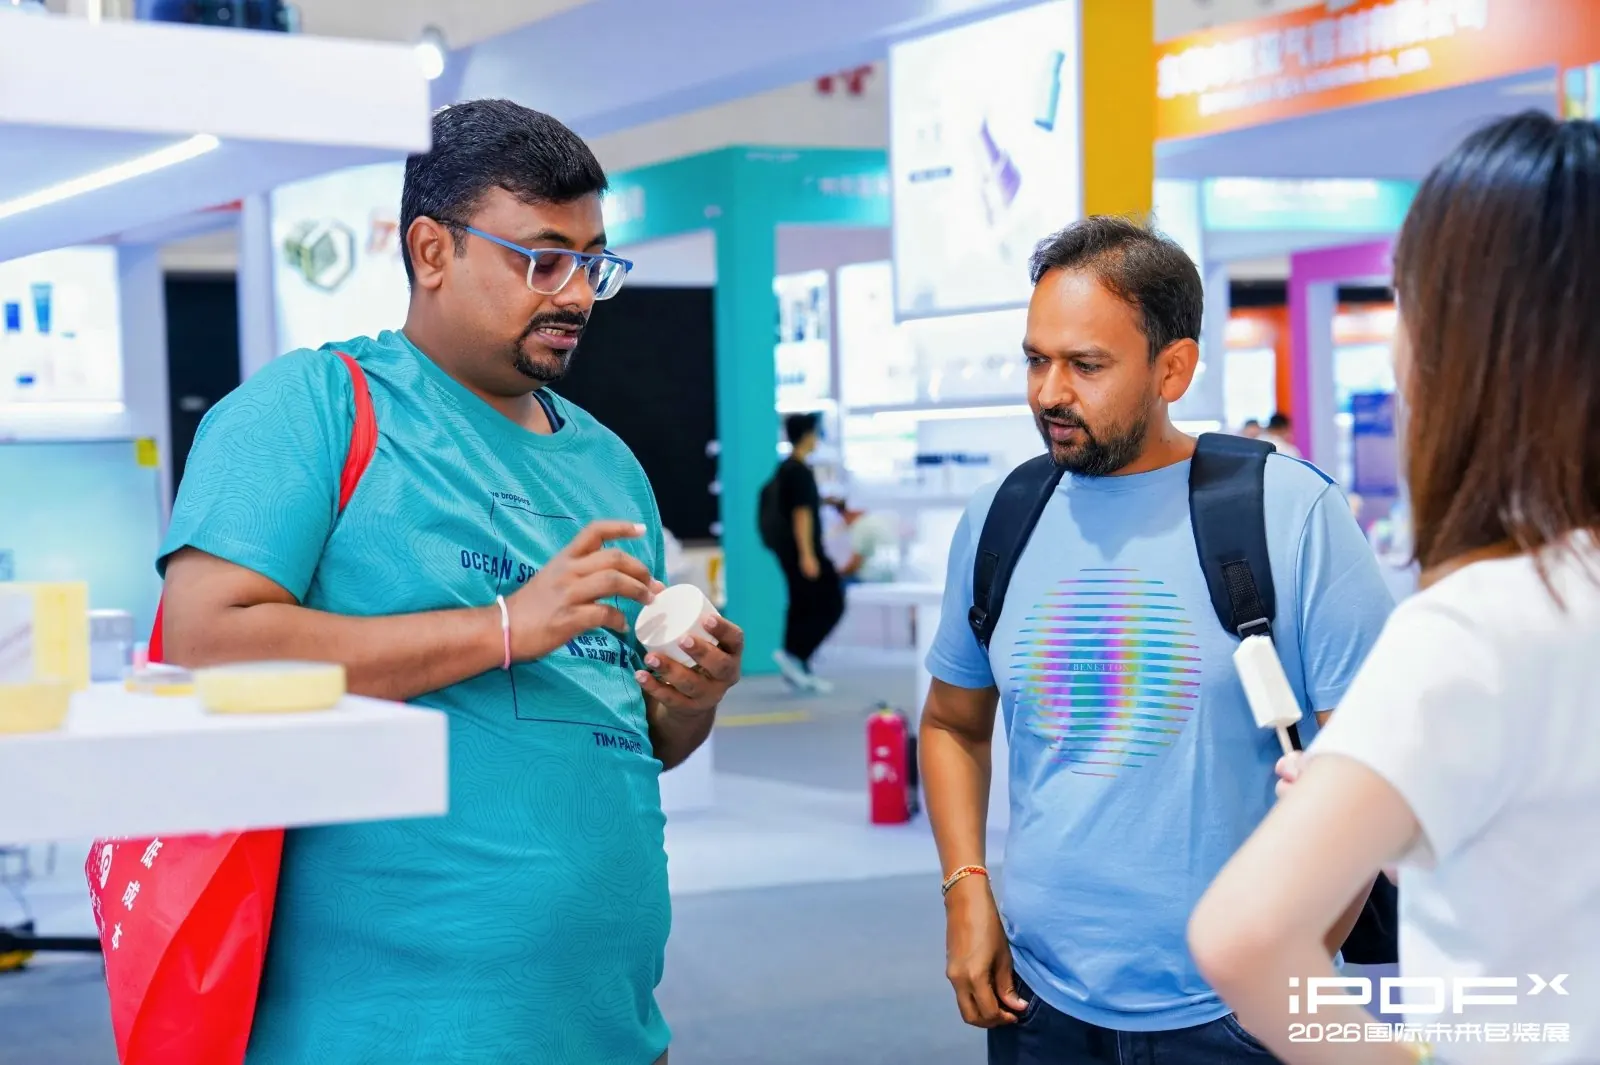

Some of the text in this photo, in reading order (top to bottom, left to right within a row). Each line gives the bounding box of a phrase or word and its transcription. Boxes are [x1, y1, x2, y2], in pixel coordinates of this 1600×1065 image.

[461, 550, 540, 583] OCEAN SP
[1073, 663, 1129, 672] BENETTON
[592, 731, 643, 755] TIM PARIS
